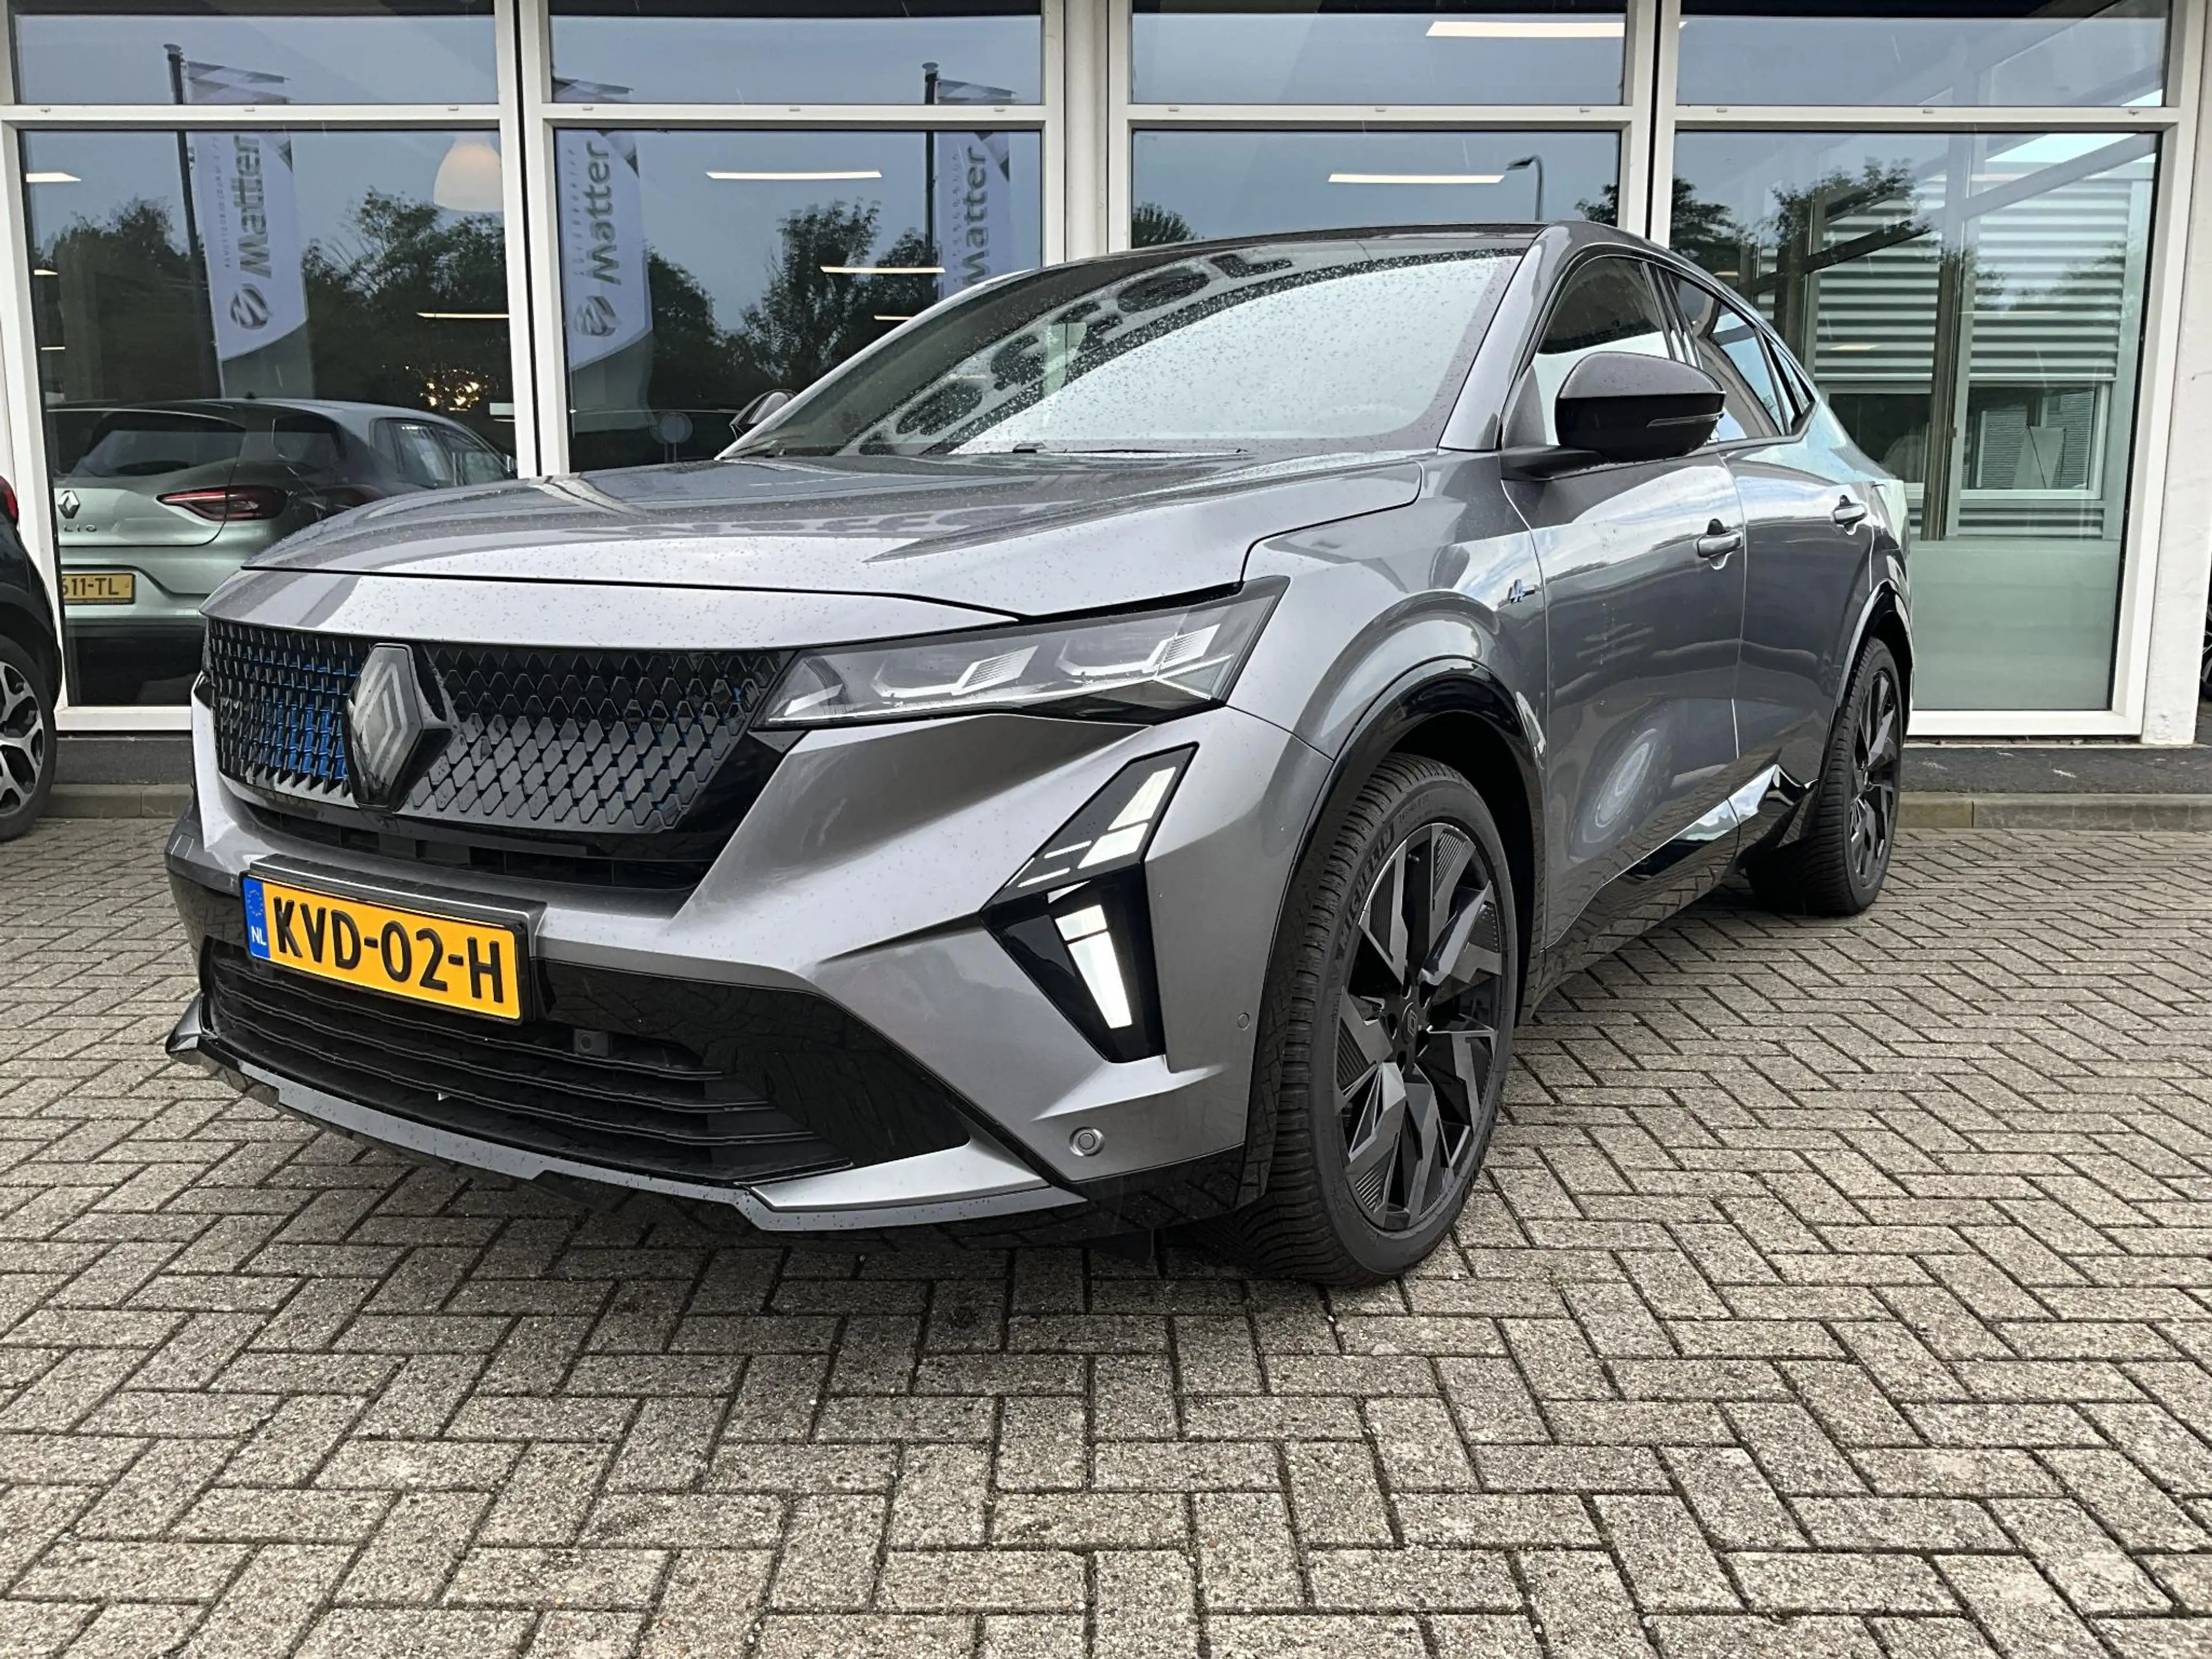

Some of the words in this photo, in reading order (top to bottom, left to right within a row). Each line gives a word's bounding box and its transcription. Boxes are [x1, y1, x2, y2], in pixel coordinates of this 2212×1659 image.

[232, 135, 272, 279] Matter
[583, 141, 622, 286] Matter
[963, 145, 990, 286] Matter
[63, 524, 97, 532] LIO
[251, 925, 267, 946] NL
[273, 896, 504, 1003] KVD-02-H
[1338, 827, 1393, 952] MICHELIN
